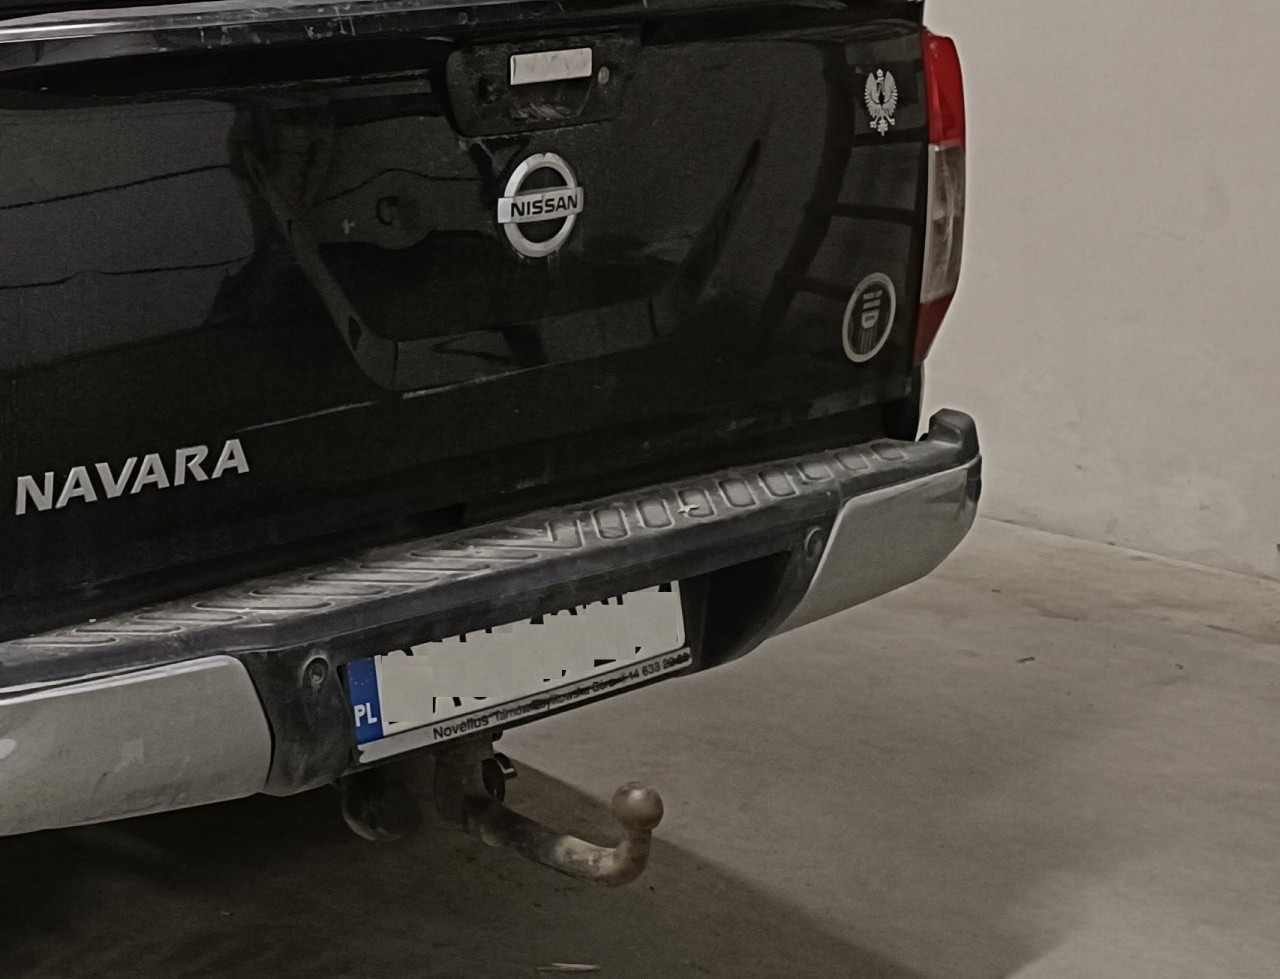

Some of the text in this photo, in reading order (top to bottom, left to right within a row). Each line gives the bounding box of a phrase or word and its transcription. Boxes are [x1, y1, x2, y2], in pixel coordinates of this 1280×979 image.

[511, 195, 578, 218] NISSAN
[16, 438, 250, 516] NAVARA
[354, 702, 378, 727] PL
